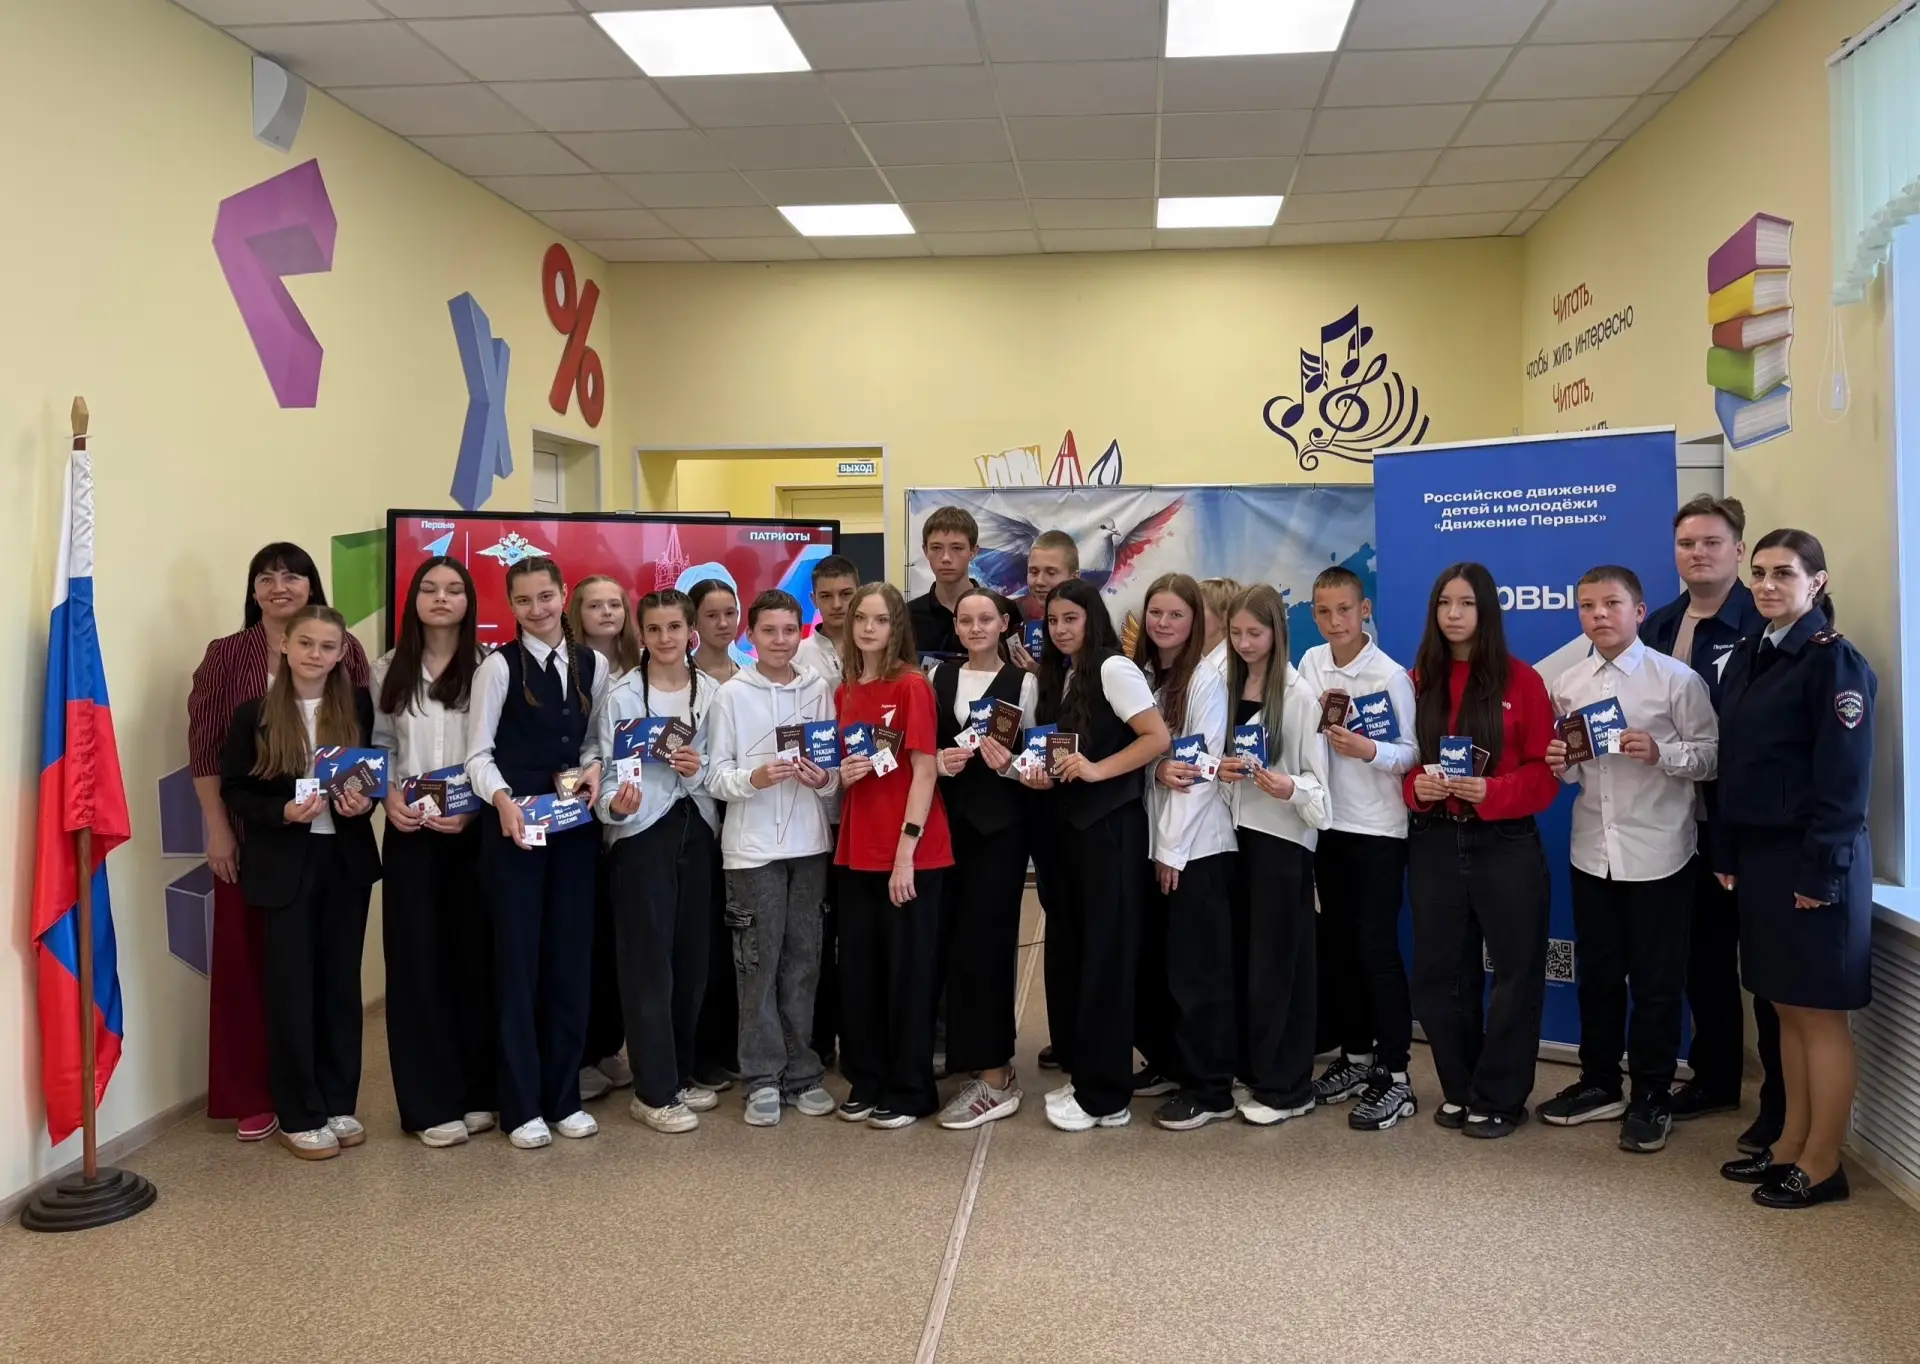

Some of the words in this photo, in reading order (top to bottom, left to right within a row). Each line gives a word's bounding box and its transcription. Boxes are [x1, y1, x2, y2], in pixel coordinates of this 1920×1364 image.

[1553, 282, 1593, 325] Читать,
[1526, 348, 1549, 380] чтобы
[1552, 341, 1572, 368] жить
[1575, 305, 1634, 355] интересно
[1553, 377, 1594, 413] Читать,
[840, 464, 873, 473] ВЫХОД
[1424, 489, 1523, 504] Российское
[1526, 484, 1617, 499] движение
[1442, 502, 1490, 517] детей
[1493, 505, 1504, 514] и
[1507, 499, 1598, 513] молодёжи
[1434, 517, 1527, 532] «Движение
[1531, 514, 1607, 527] Первых»
[749, 532, 811, 541] ПАТРИОТЫ
[1496, 585, 1575, 611] рвы
